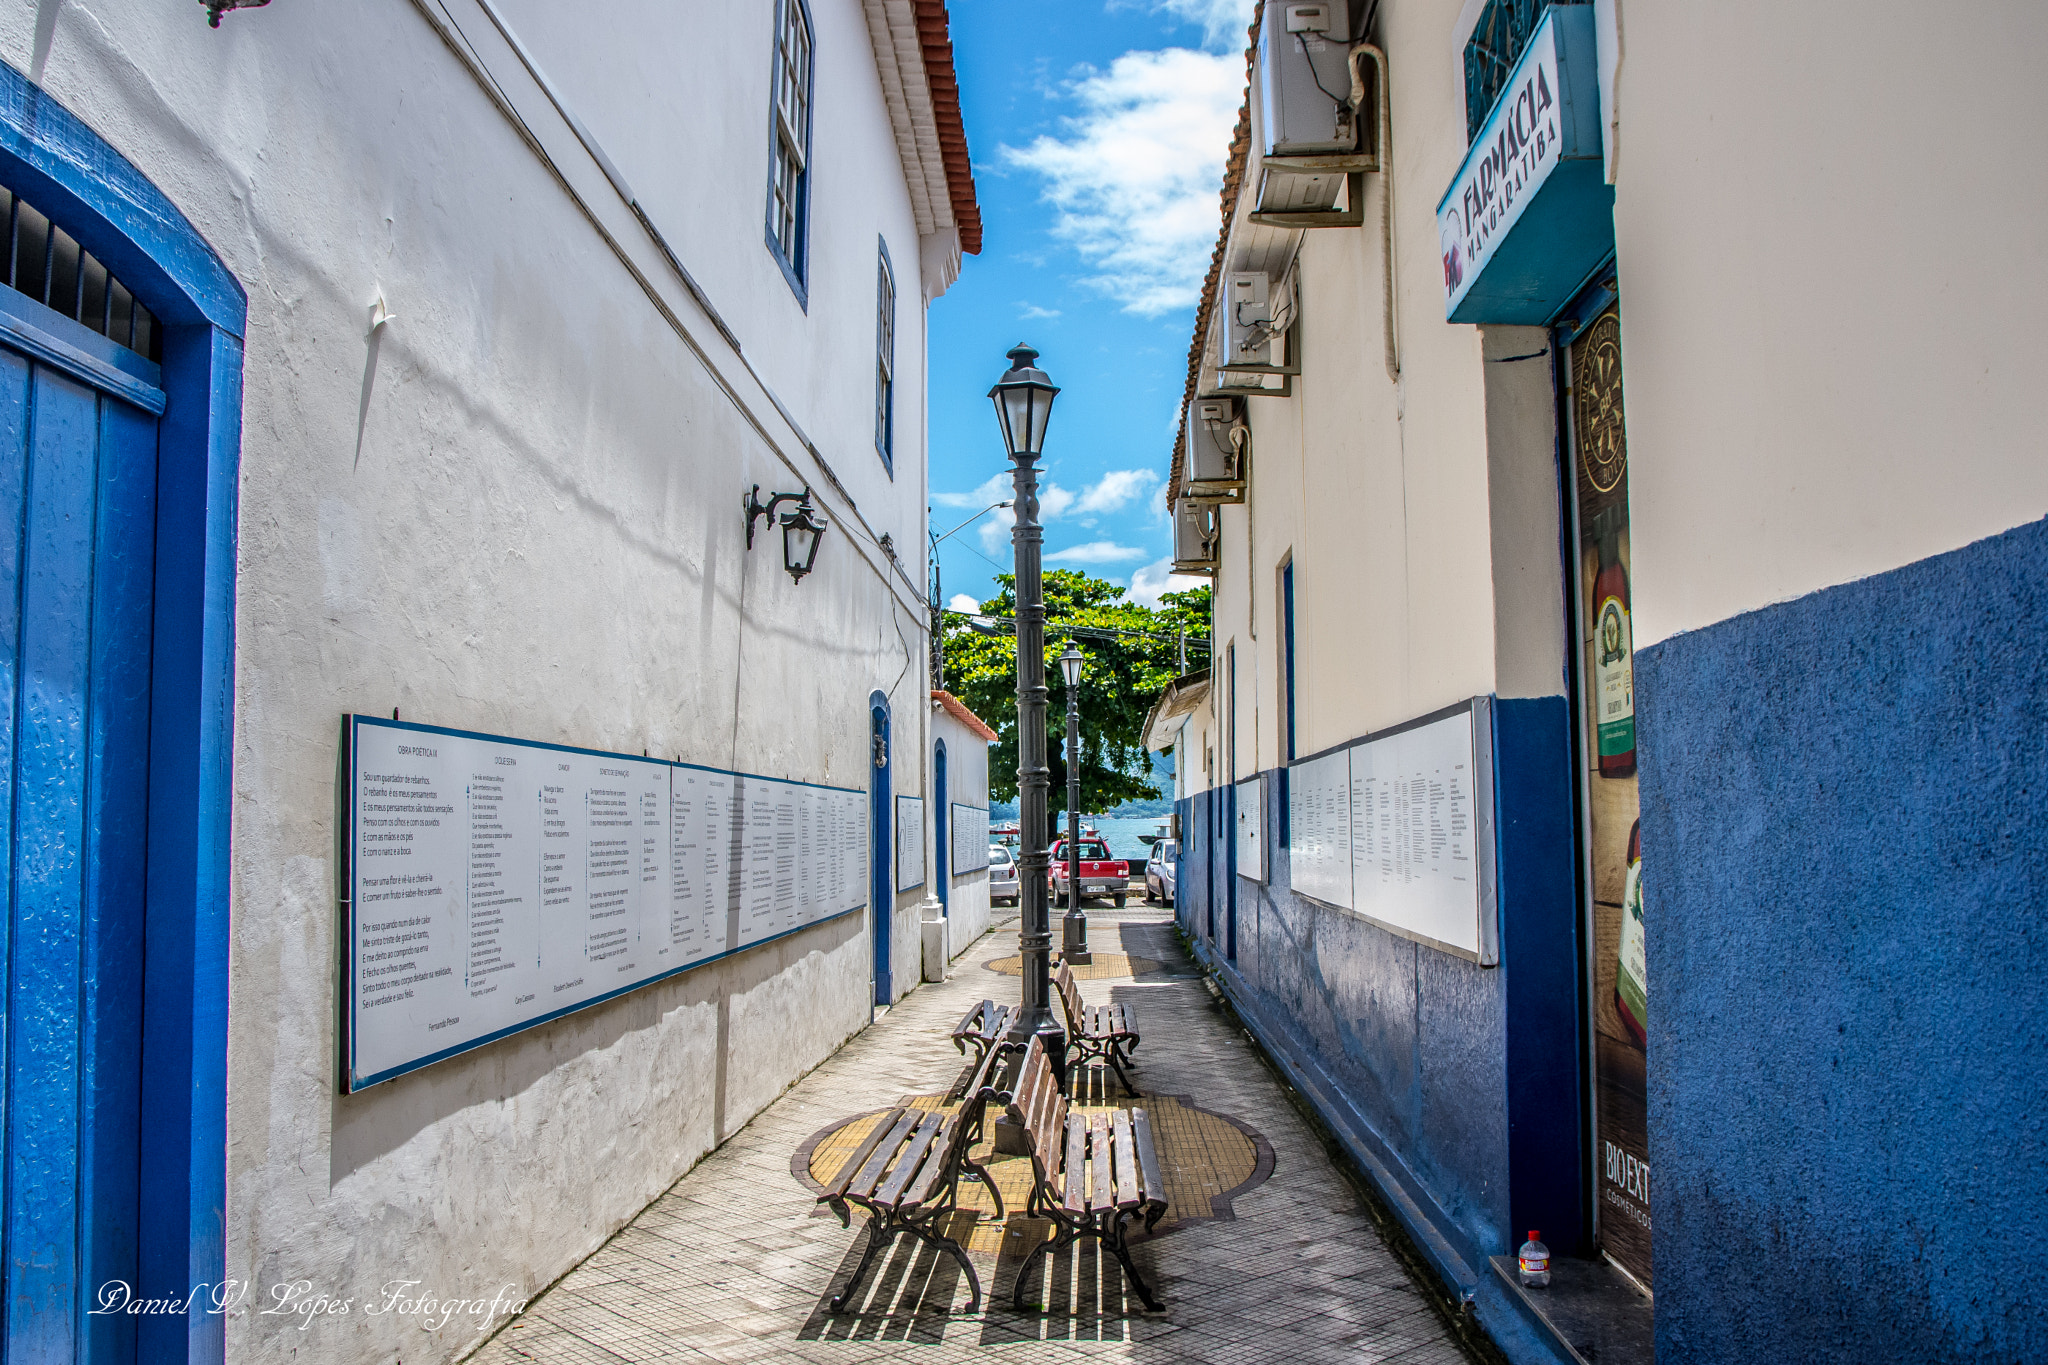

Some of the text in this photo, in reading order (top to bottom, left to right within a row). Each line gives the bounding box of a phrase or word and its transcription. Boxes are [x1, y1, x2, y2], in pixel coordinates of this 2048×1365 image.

[1463, 62, 1553, 238] FARMÁCIA
[1467, 117, 1556, 267] MANGARATIBA
[398, 745, 412, 755] OBRA
[364, 772, 372, 782] Sou
[374, 774, 381, 782] um
[382, 774, 404, 785] guardador
[364, 787, 368, 796] O
[369, 787, 387, 797] rebanho
[411, 791, 437, 800] pensamentos
[364, 802, 367, 811] E
[387, 804, 415, 814] pensamentos
[363, 817, 377, 826] Penso
[363, 832, 366, 841] E
[363, 848, 366, 856] E
[363, 878, 379, 887] Pensar
[363, 893, 366, 902] E
[367, 894, 381, 902] comer
[363, 923, 371, 933] Por
[363, 938, 370, 948] Me
[363, 954, 366, 963] E
[367, 954, 374, 963] me
[363, 969, 366, 979] E
[1605, 1140, 1650, 1205] BIO EXT
